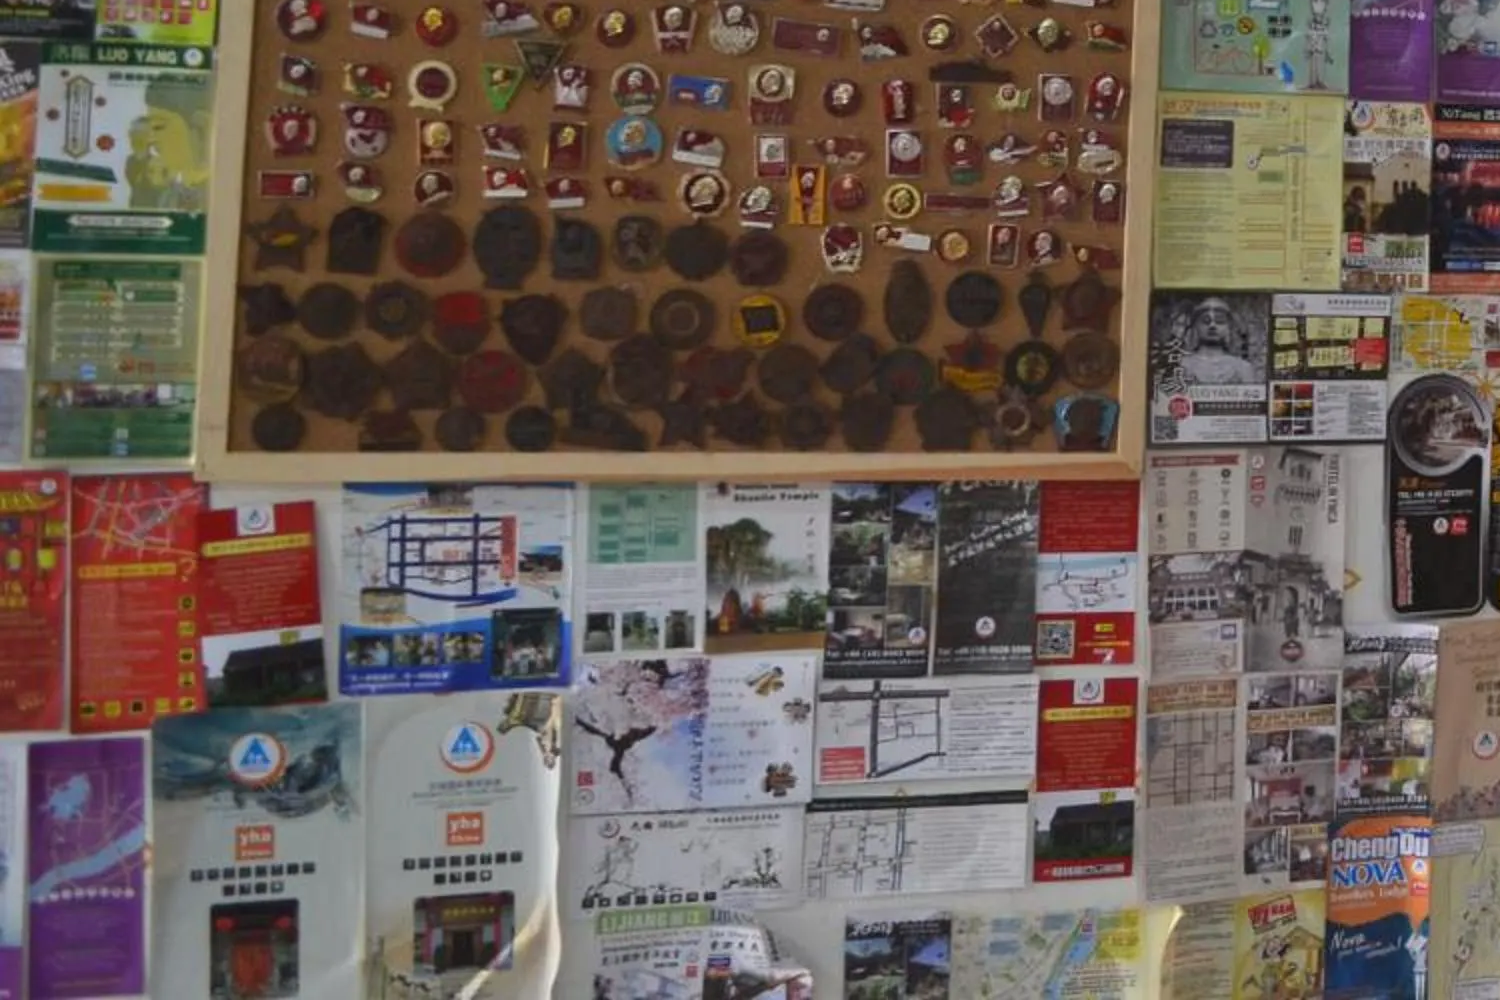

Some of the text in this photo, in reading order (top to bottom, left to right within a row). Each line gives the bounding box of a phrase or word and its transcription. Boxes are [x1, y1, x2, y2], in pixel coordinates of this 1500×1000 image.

[97, 47, 129, 62] LUO
[135, 48, 177, 65] YANG
[450, 815, 482, 834] yha
[240, 829, 272, 847] yha
[1331, 859, 1408, 888] NOVA
